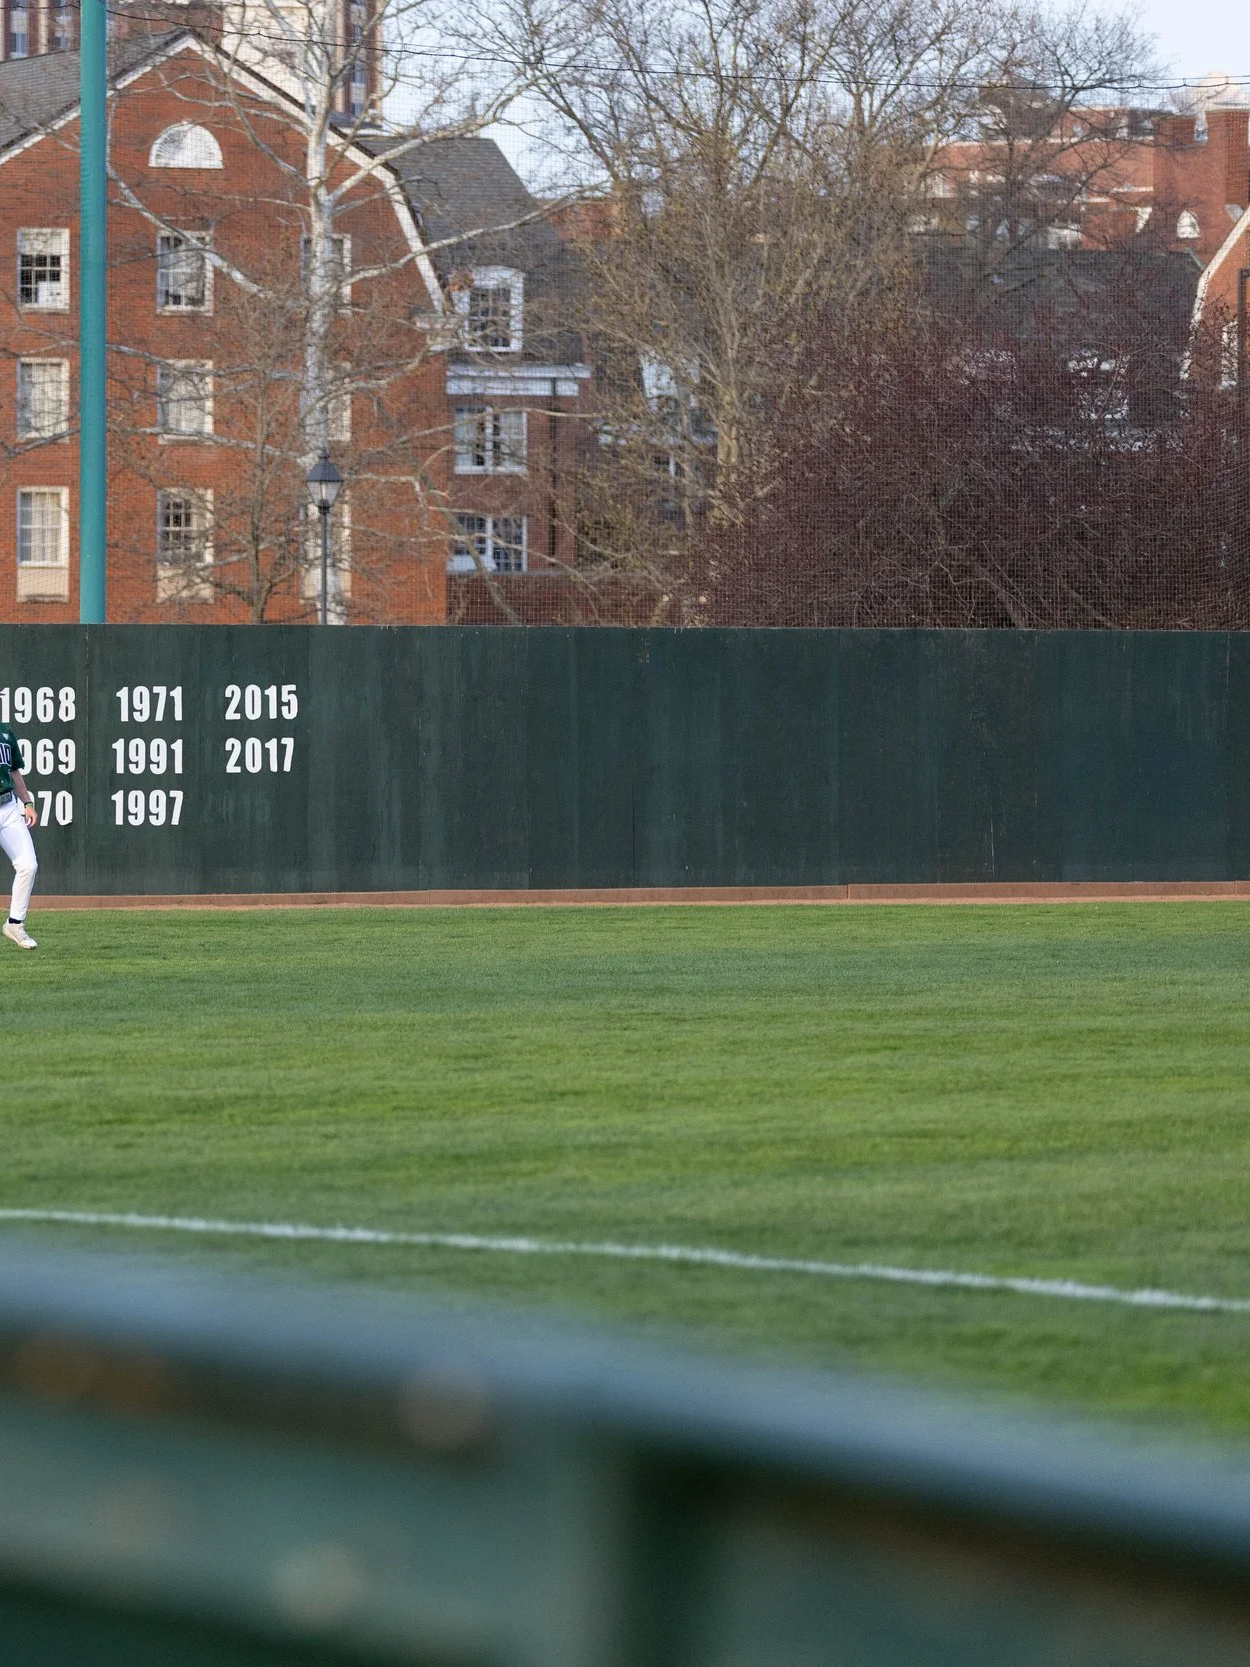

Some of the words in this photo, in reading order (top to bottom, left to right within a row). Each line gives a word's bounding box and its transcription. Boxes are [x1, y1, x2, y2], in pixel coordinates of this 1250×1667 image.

[115, 685, 183, 723] 1971
[224, 683, 299, 721] 2015
[17, 738, 76, 776] 969
[111, 737, 183, 775] 1991
[224, 736, 295, 774] 2017
[26, 790, 73, 827] 70
[110, 789, 184, 827] 1997
